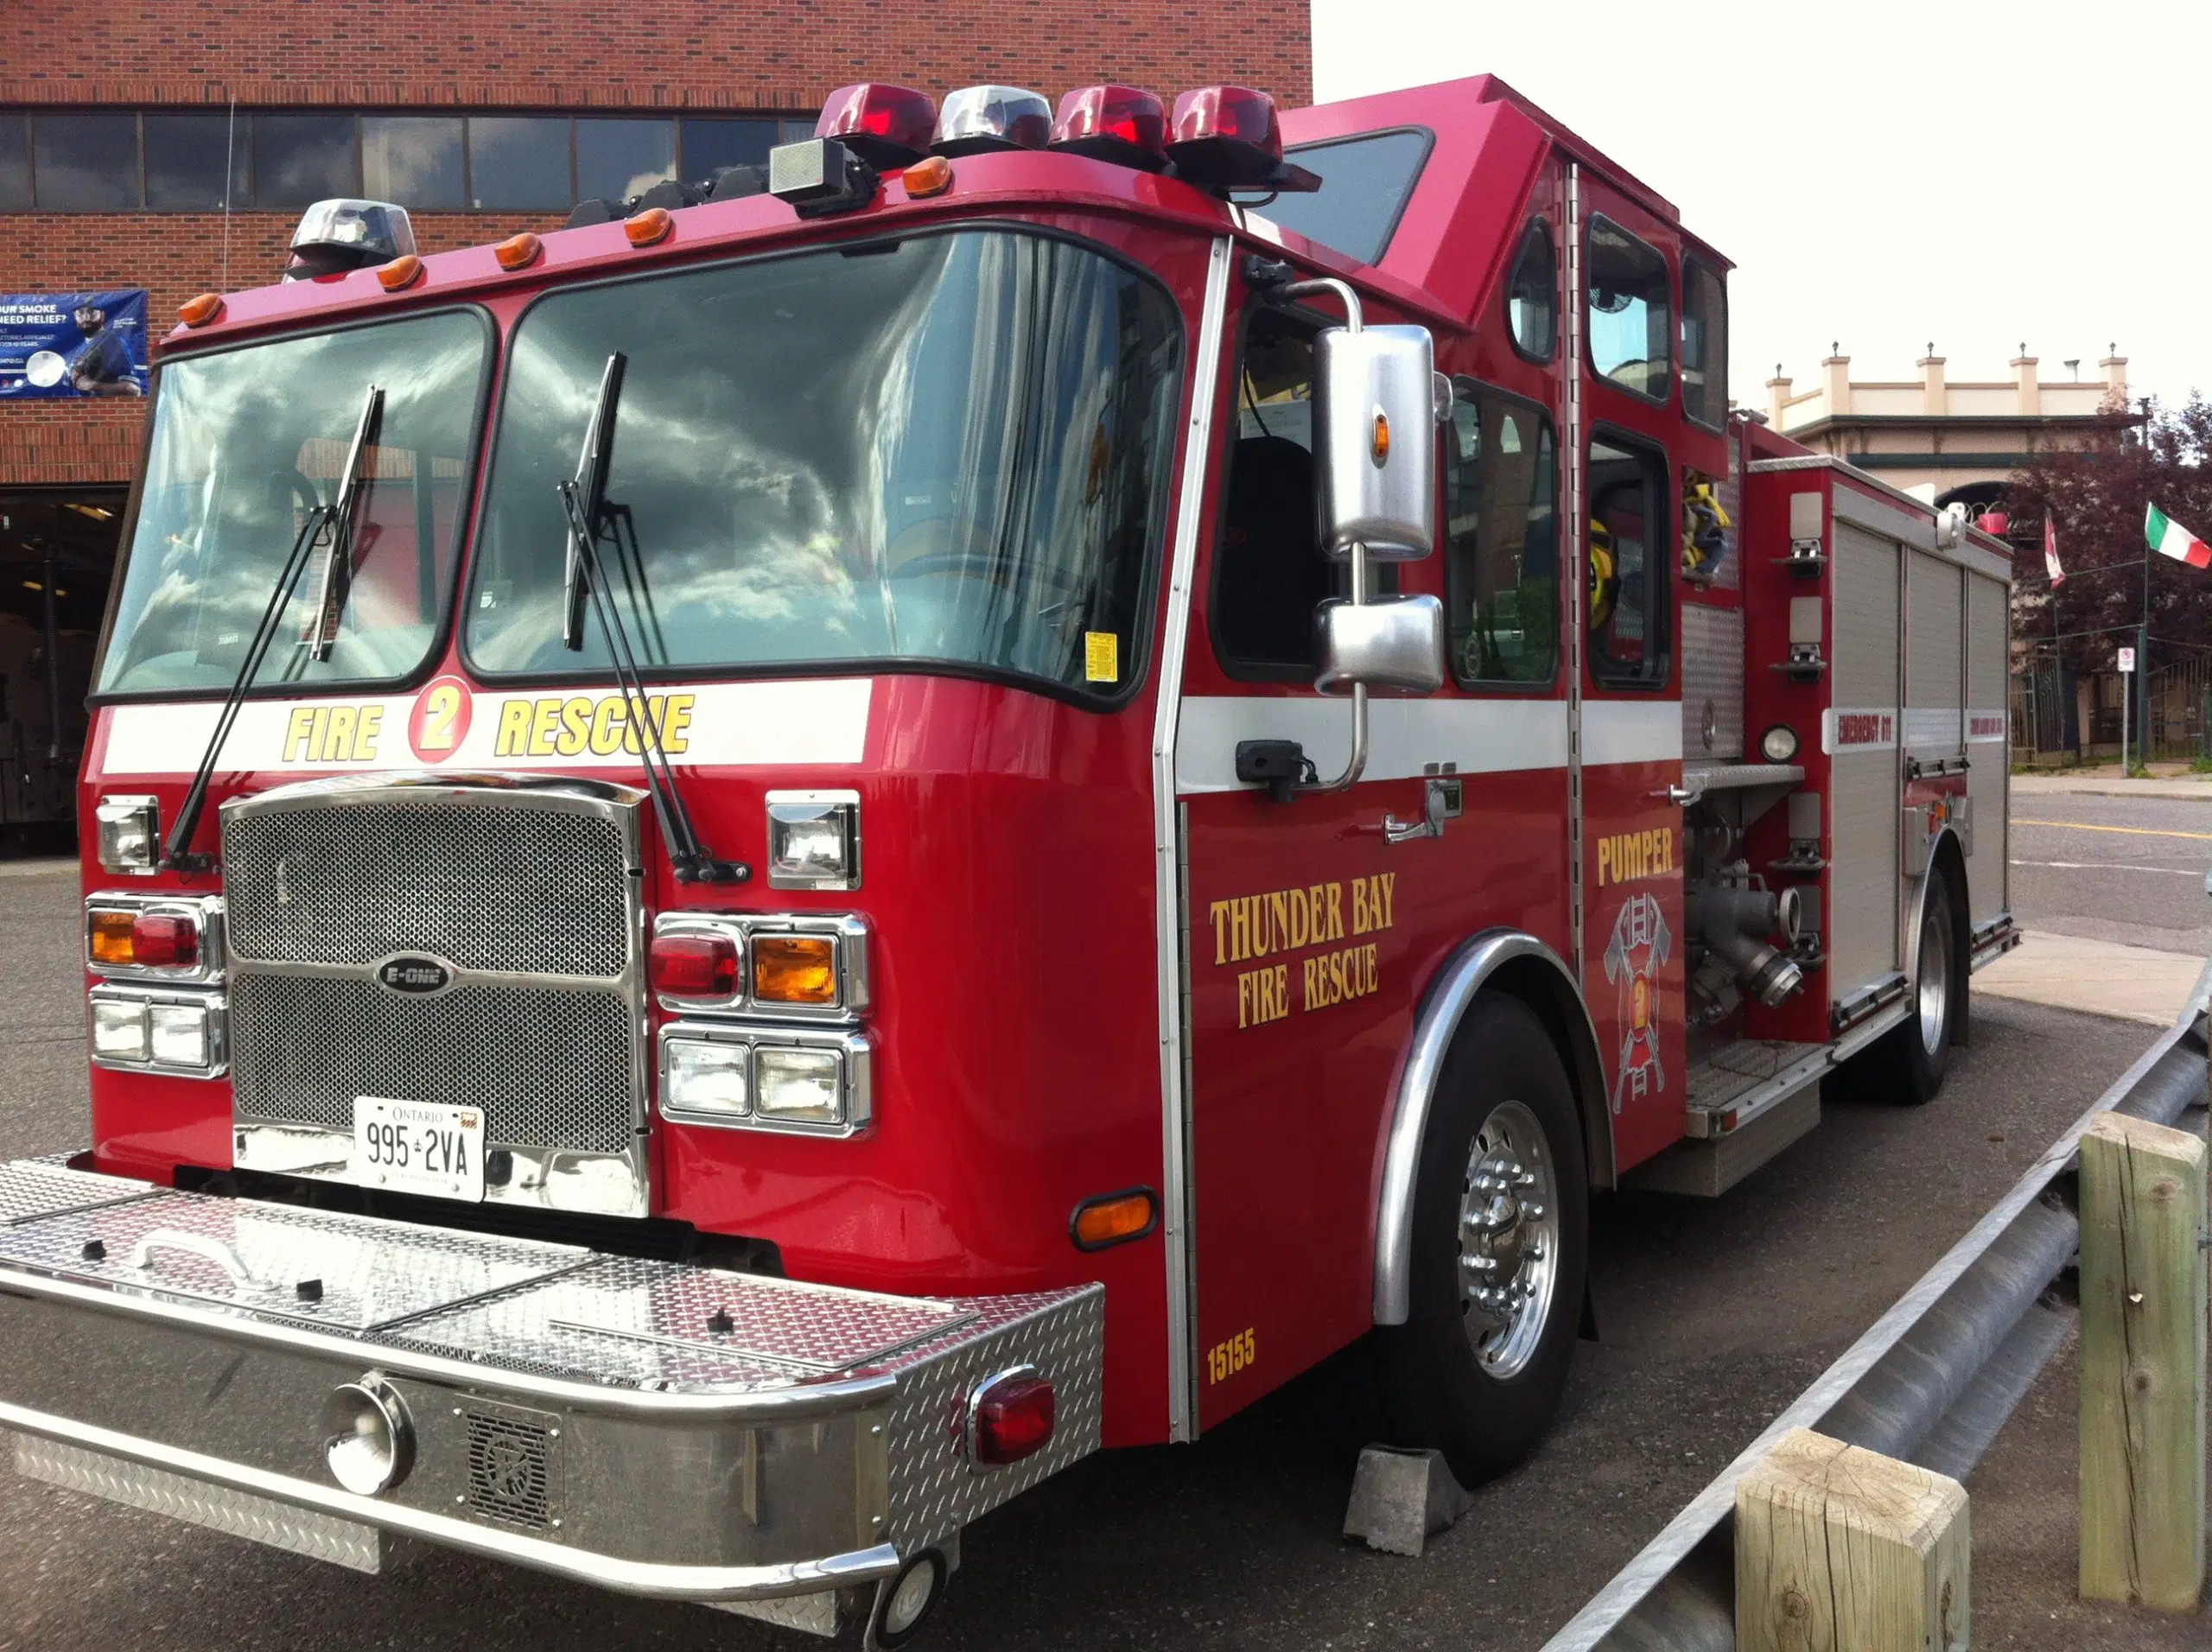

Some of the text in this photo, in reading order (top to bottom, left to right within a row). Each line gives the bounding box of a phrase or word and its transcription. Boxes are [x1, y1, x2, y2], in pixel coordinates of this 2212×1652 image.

[0, 304, 57, 314] UR SMOKE
[26, 315, 67, 324] RELIEF?
[282, 685, 696, 762] FIRE 2 RESCUE
[1599, 827, 1673, 886] PUMPER
[1209, 872, 1396, 966] THUNDER BAY
[386, 966, 442, 985] E-ONE
[1237, 943, 1379, 1030] FIRE RESCUE
[392, 1106, 443, 1123] ONTARIO
[366, 1121, 467, 1176] 995 2VA
[1207, 1327, 1255, 1386] 15155
